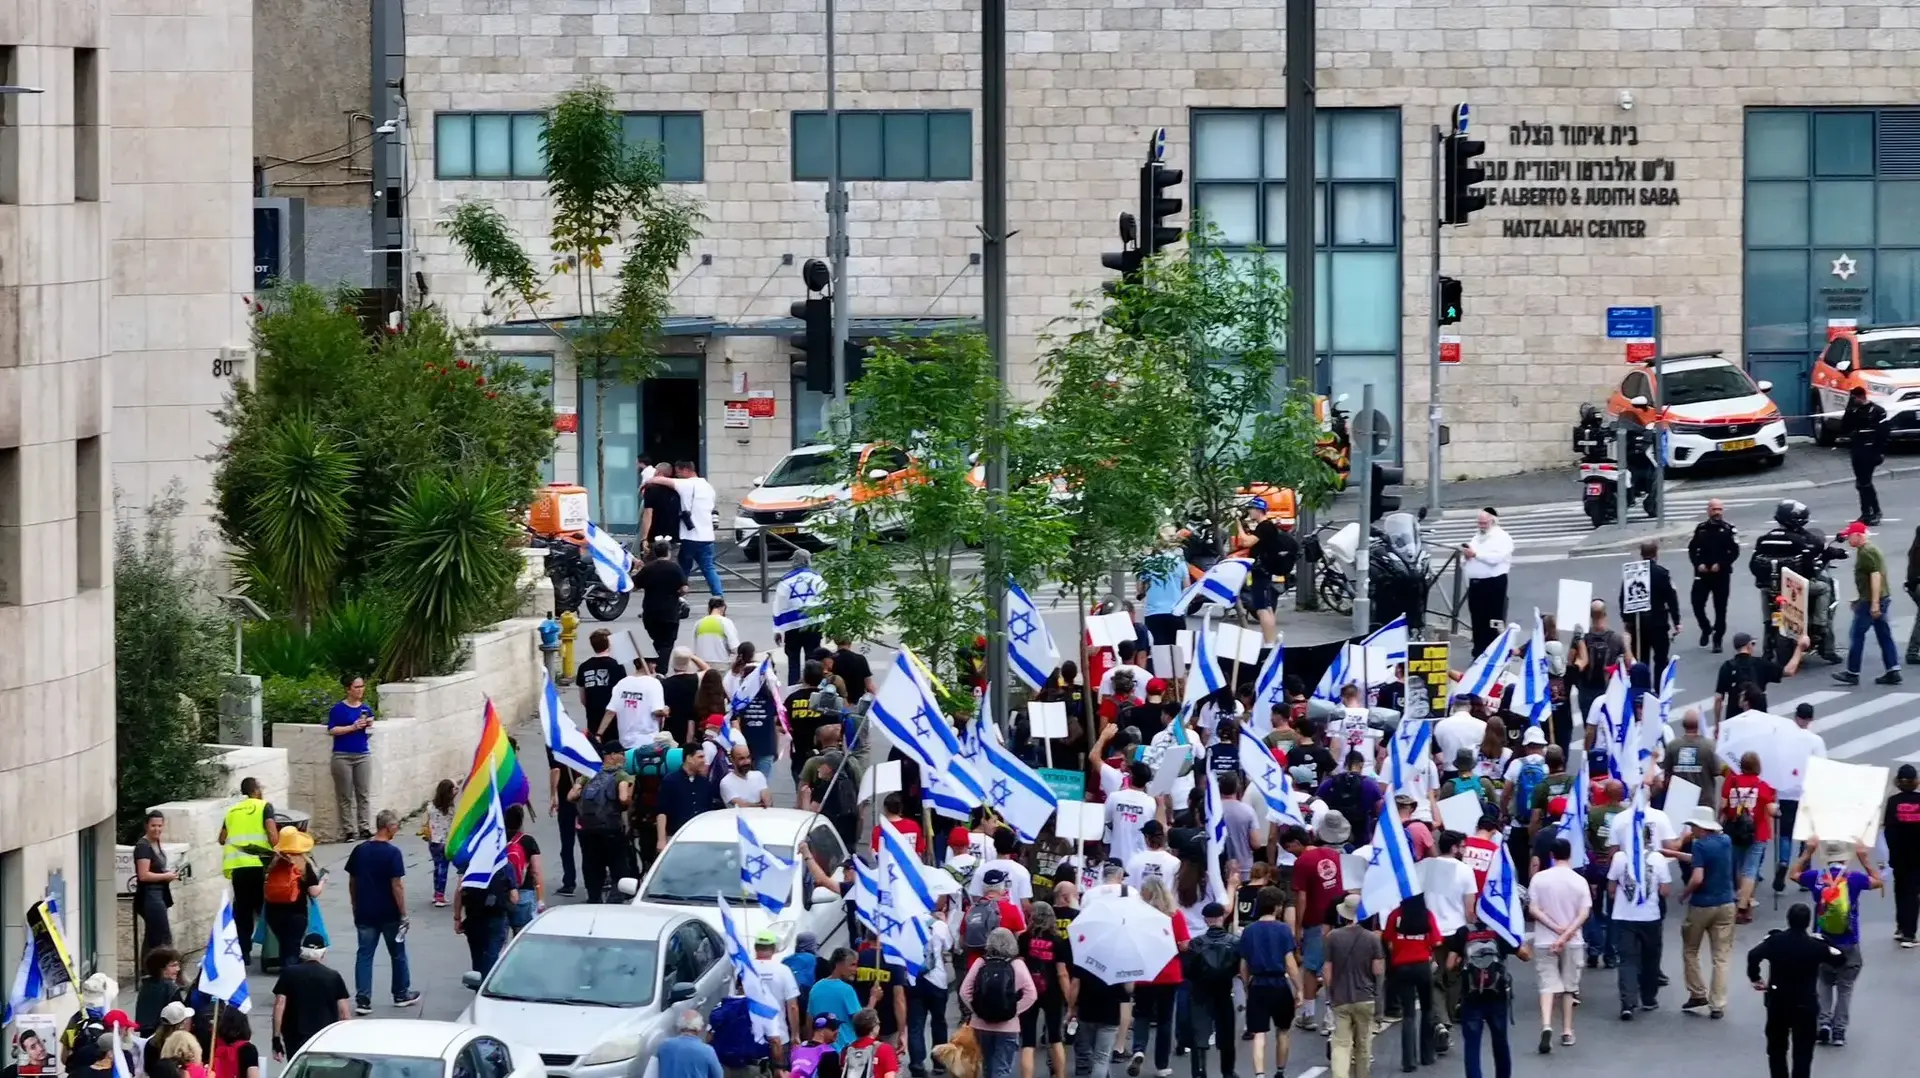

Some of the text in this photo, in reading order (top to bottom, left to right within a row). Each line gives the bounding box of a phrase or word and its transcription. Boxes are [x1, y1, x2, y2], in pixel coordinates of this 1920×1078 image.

[1510, 120, 1639, 146] בית איחוד הצלה
[1514, 160, 1571, 181] ויהודית
[1576, 155, 1636, 181] אלברטו
[1500, 187, 1567, 206] ALBERTO
[1569, 187, 1582, 206] &
[1584, 187, 1636, 206] JUDITH
[1639, 187, 1681, 206] SABA
[1503, 219, 1647, 238] HATZALAH CENTER
[212, 358, 233, 378] 80
